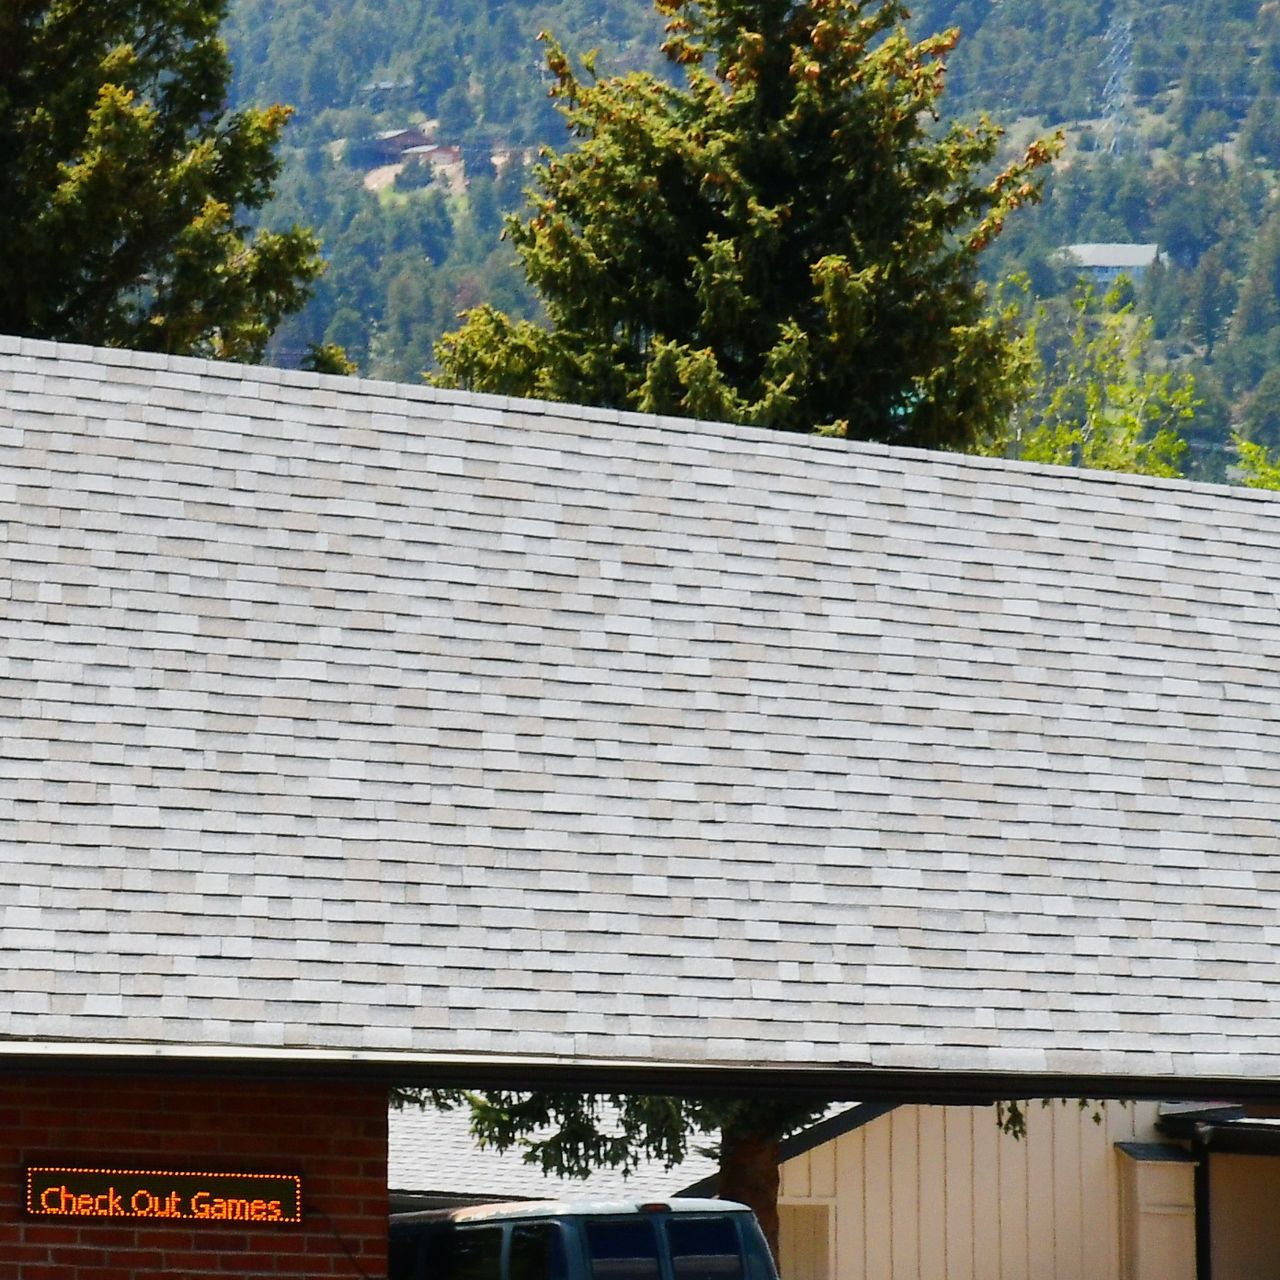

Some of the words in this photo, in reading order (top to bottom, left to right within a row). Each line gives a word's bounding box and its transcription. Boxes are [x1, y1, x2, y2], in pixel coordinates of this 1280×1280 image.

[41, 1186, 123, 1215] Check
[131, 1189, 181, 1217] Out
[191, 1191, 282, 1220] Games
